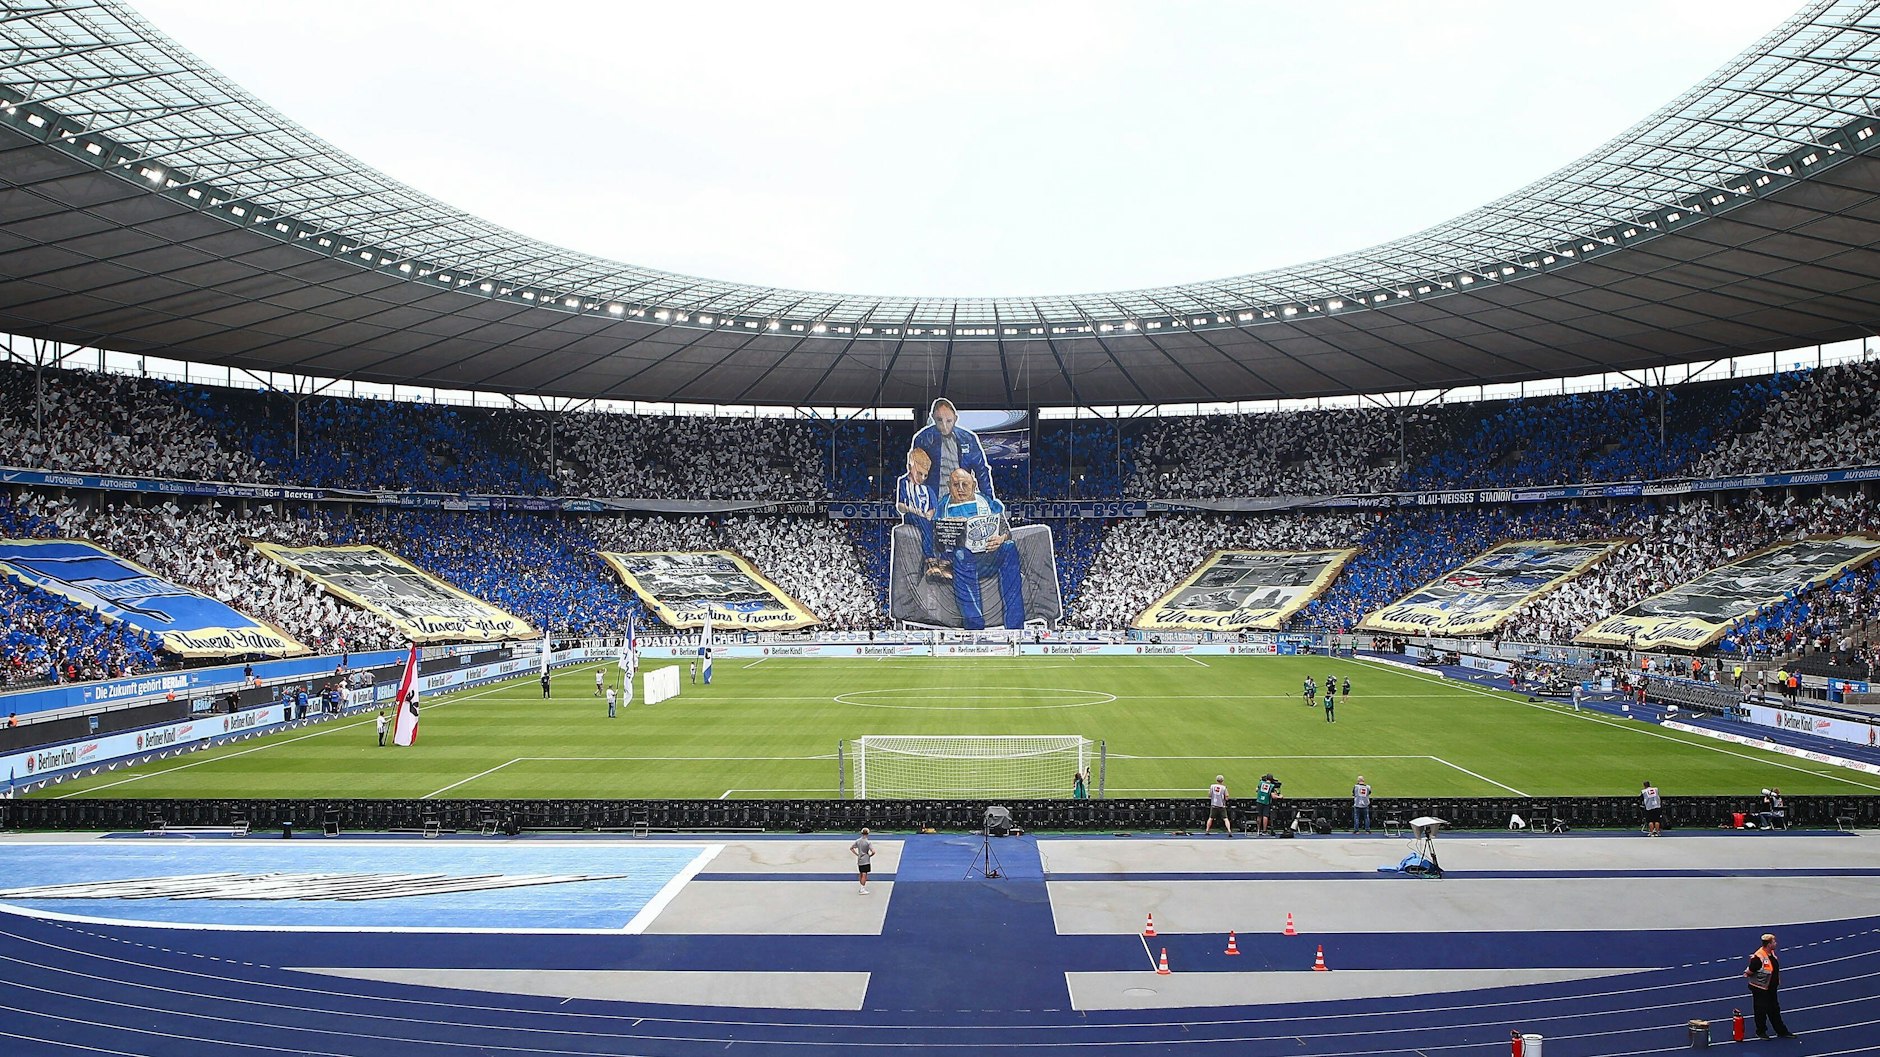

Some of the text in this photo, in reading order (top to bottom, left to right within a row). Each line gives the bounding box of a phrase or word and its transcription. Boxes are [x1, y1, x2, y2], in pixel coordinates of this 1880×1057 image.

[44, 475, 84, 486] AUTOHERO
[100, 479, 138, 489] AUTOHERO
[1788, 473, 1829, 484] AUTOHERO
[1418, 492, 1474, 505] BLAU-WEISSES
[1480, 491, 1512, 503] STADION
[842, 503, 900, 518] OSTK
[1010, 503, 1082, 518] ERTHA
[1093, 503, 1137, 518] BSC
[968, 516, 999, 530] HERTHA
[737, 611, 797, 624] Freunde
[1382, 607, 1441, 625] Unsere
[405, 617, 465, 634] Unsere
[163, 632, 234, 649] Unsere
[679, 647, 697, 656] Berliner
[771, 647, 789, 655] Berliner
[789, 647, 803, 655] Kindl
[864, 646, 882, 655] Berliner
[883, 646, 896, 655] Kindl
[1051, 646, 1069, 654] Berliner
[1069, 646, 1082, 654] Kindl
[1145, 646, 1163, 654] Berliner
[1163, 646, 1176, 654] Kindl
[1238, 646, 1267, 654] Berliner Kind
[95, 686, 107, 700] Die
[108, 682, 137, 699] Zukunft
[138, 678, 161, 695] gehört
[231, 711, 255, 730] Berliner Kindl
[1784, 713, 1813, 732] Berliner Kindl
[145, 727, 176, 748] Berliner Kindl
[38, 746, 76, 770] Berliner Kindl
